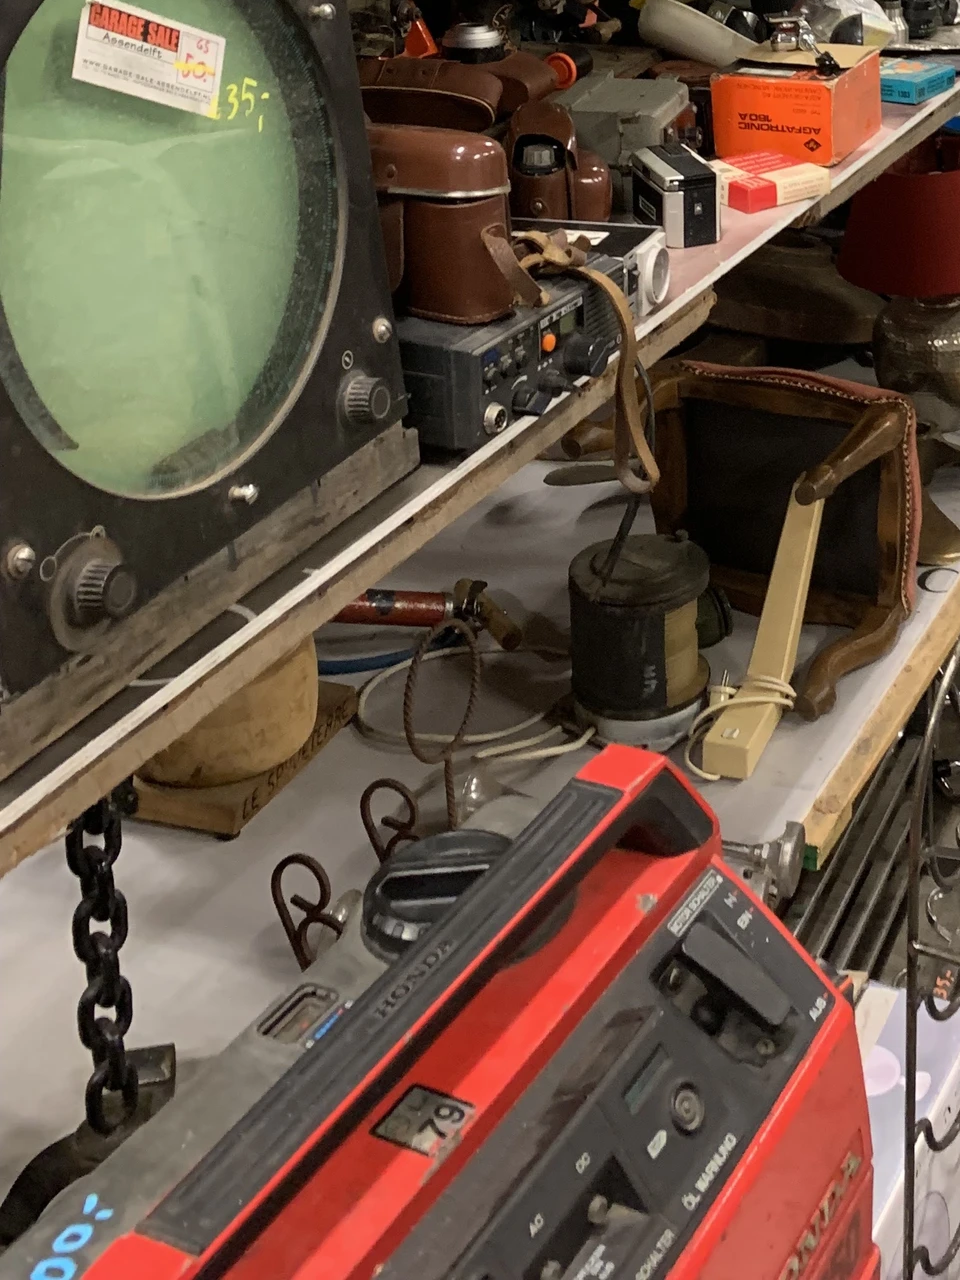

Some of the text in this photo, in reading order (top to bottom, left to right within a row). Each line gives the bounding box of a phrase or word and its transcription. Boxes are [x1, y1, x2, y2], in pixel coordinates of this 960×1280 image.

[90, 3, 180, 52] GARAGE SALE
[102, 32, 163, 59] Assendelft
[738, 121, 821, 135] AGFATRONIC
[374, 940, 455, 1018] HONDA
